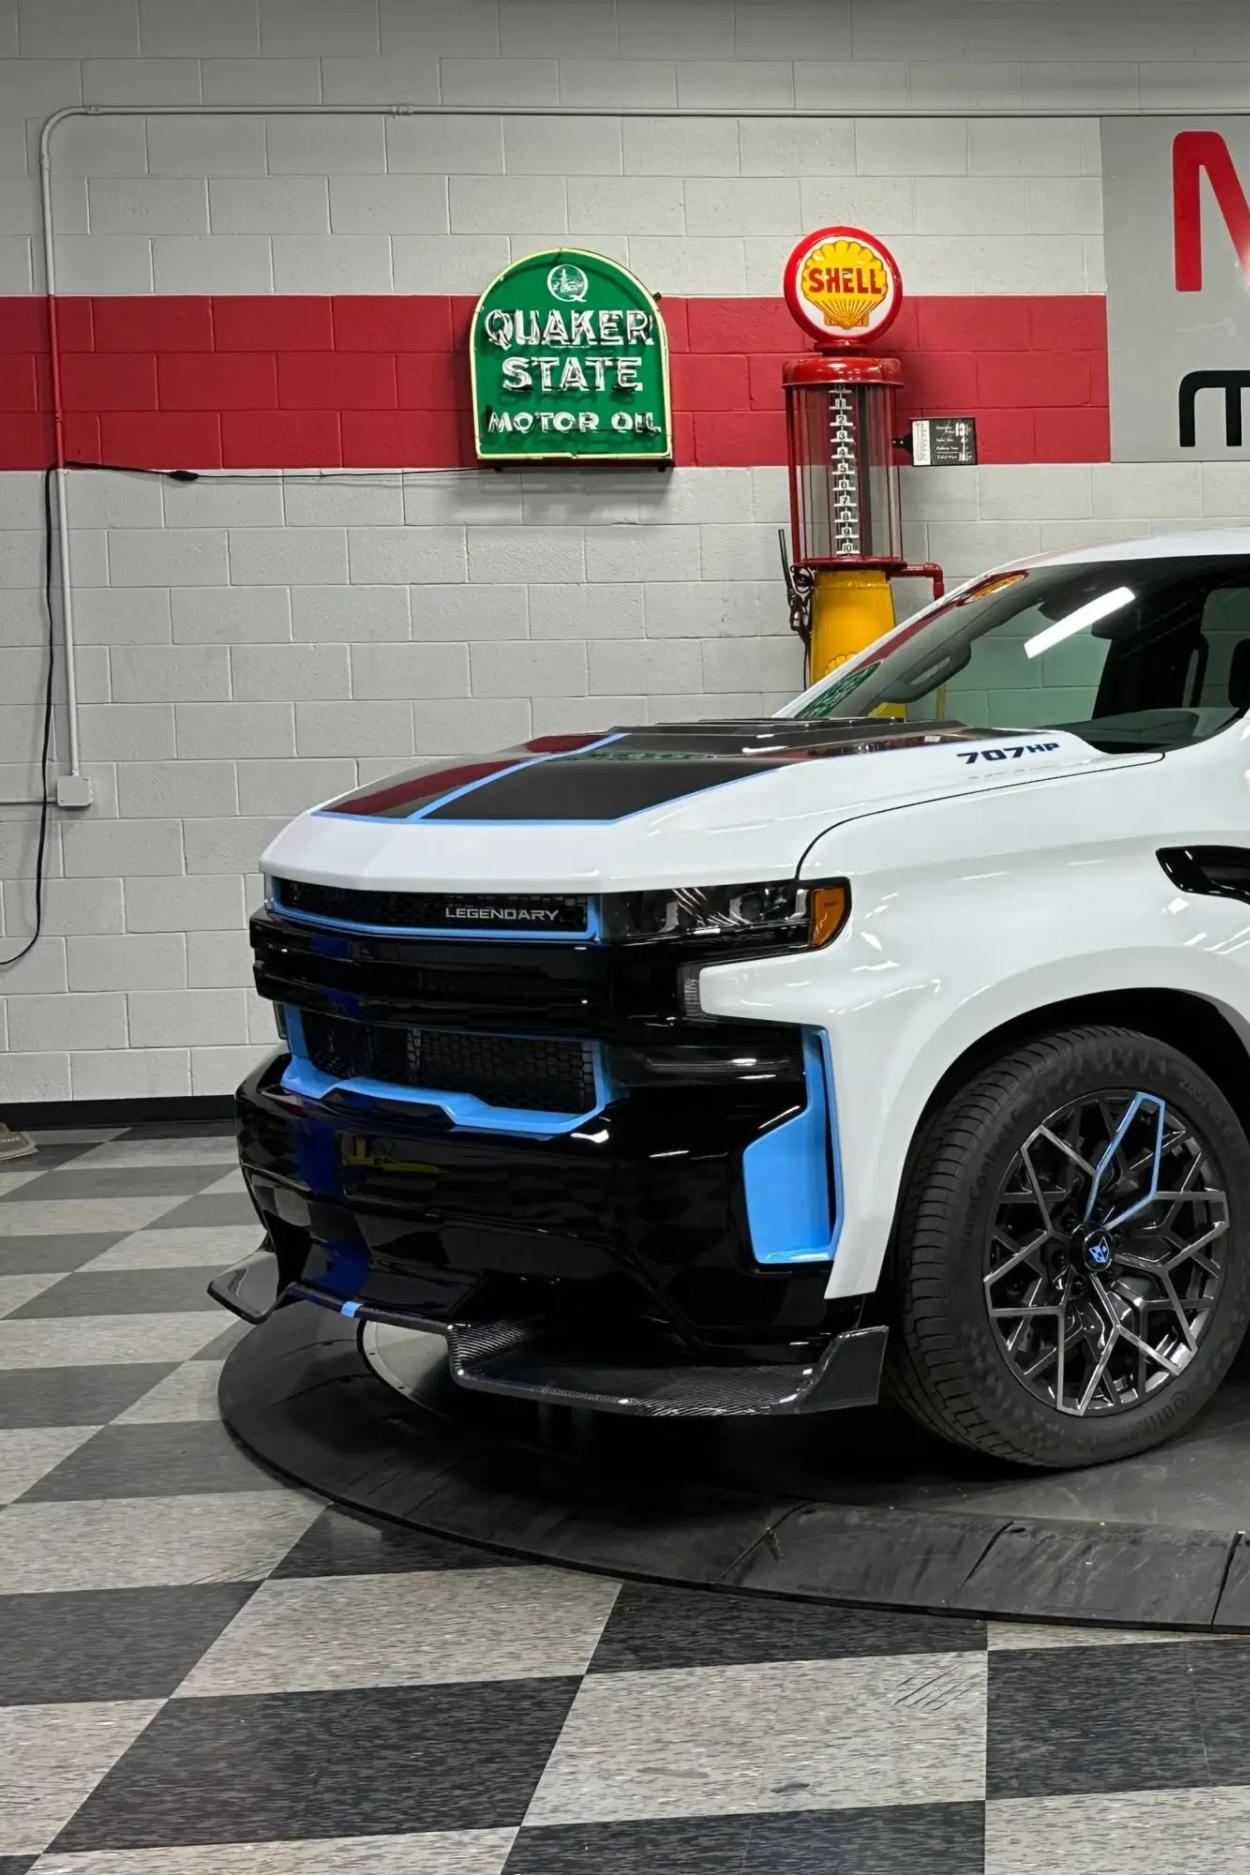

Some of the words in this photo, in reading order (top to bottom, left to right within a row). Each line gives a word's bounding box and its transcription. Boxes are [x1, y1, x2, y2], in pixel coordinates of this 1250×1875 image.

[808, 267, 882, 294] SHELL
[485, 309, 654, 350] QUAKER
[502, 357, 644, 392] STATE
[489, 411, 600, 434] MOTOR
[611, 411, 661, 435] OIL
[445, 907, 559, 921] LEGENDARY
